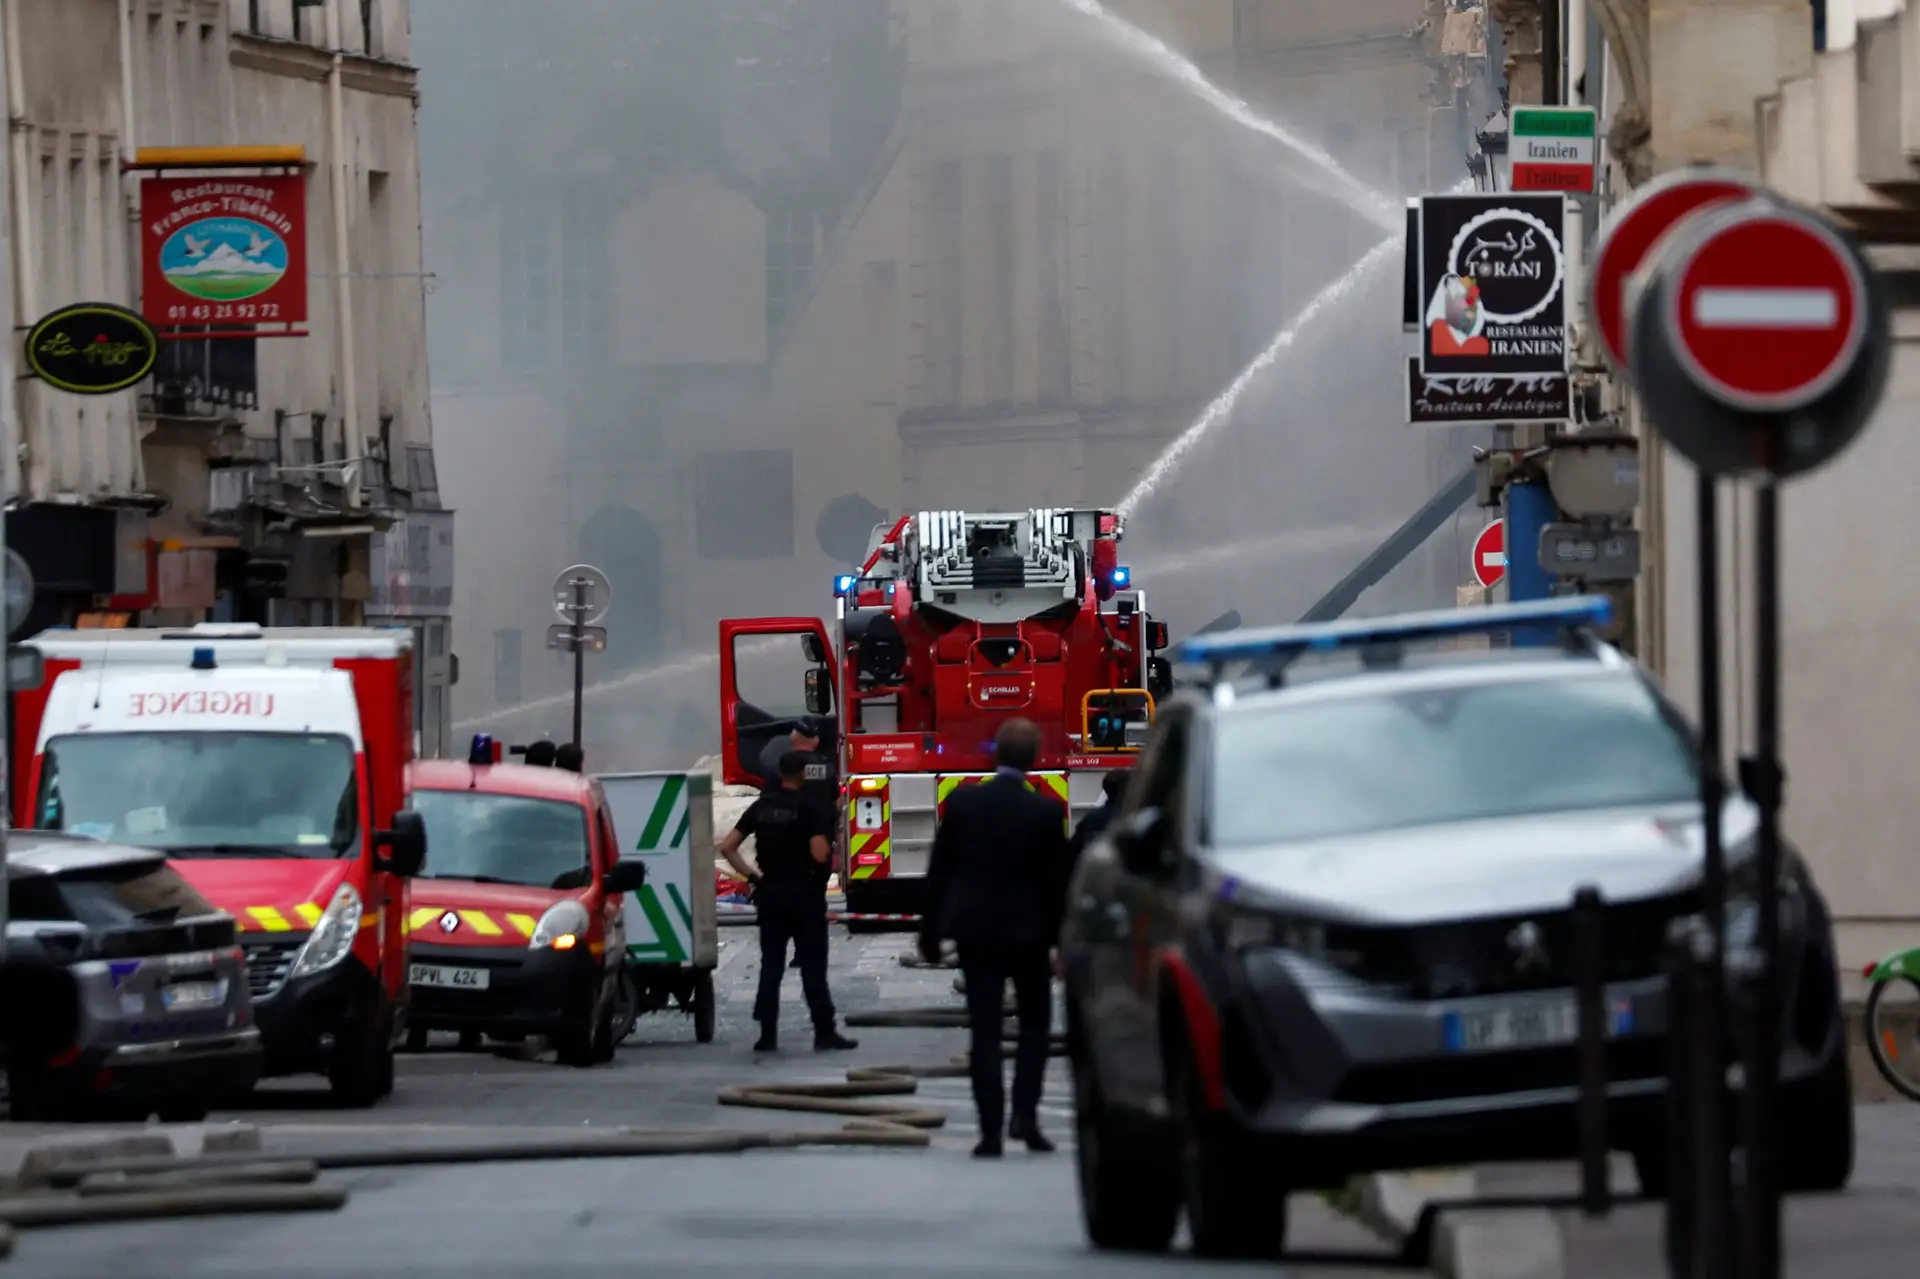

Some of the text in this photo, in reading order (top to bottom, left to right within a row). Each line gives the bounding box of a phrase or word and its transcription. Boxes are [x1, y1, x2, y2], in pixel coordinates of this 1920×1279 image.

[1528, 141, 1578, 159] Iranien
[171, 183, 275, 202] Restaurant
[168, 305, 187, 319] 01
[192, 305, 210, 319] 43
[1486, 325, 1564, 338] RESTAURANT
[1491, 340, 1563, 356] IRANIEN
[1414, 398, 1482, 412] Traiteur
[411, 966, 444, 983] SPVL
